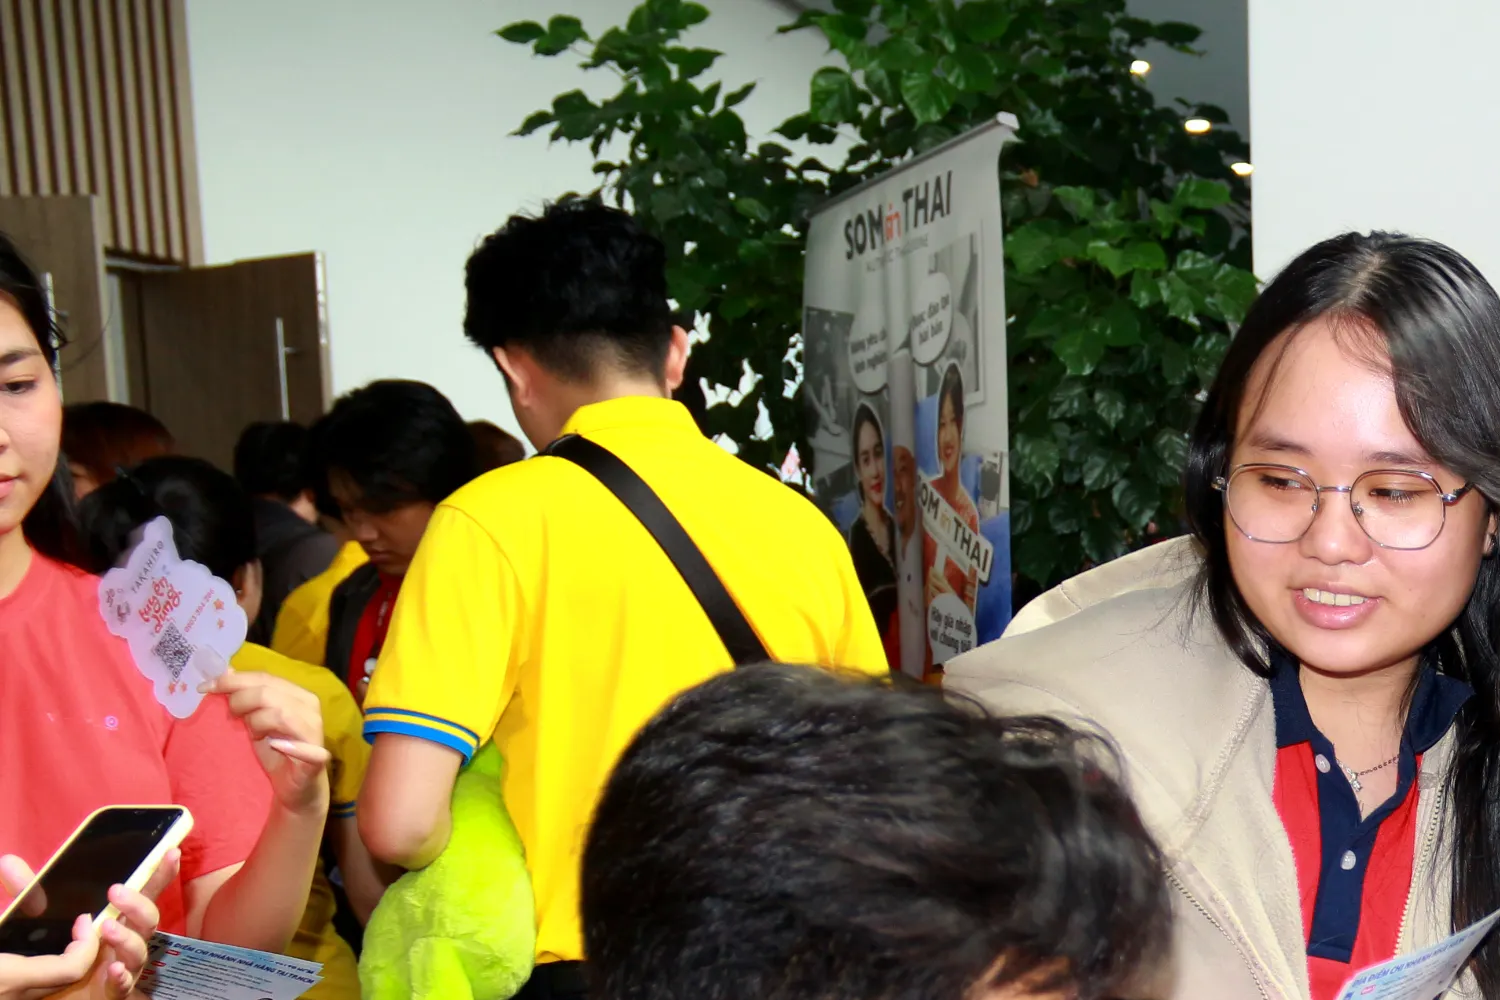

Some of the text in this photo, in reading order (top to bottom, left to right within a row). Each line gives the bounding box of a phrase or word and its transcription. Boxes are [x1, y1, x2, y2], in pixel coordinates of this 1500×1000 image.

[902, 170, 953, 234] THAI
[844, 204, 884, 260] SOM
[131, 540, 164, 595] TAKAHIRO
[953, 517, 989, 573] THAI
